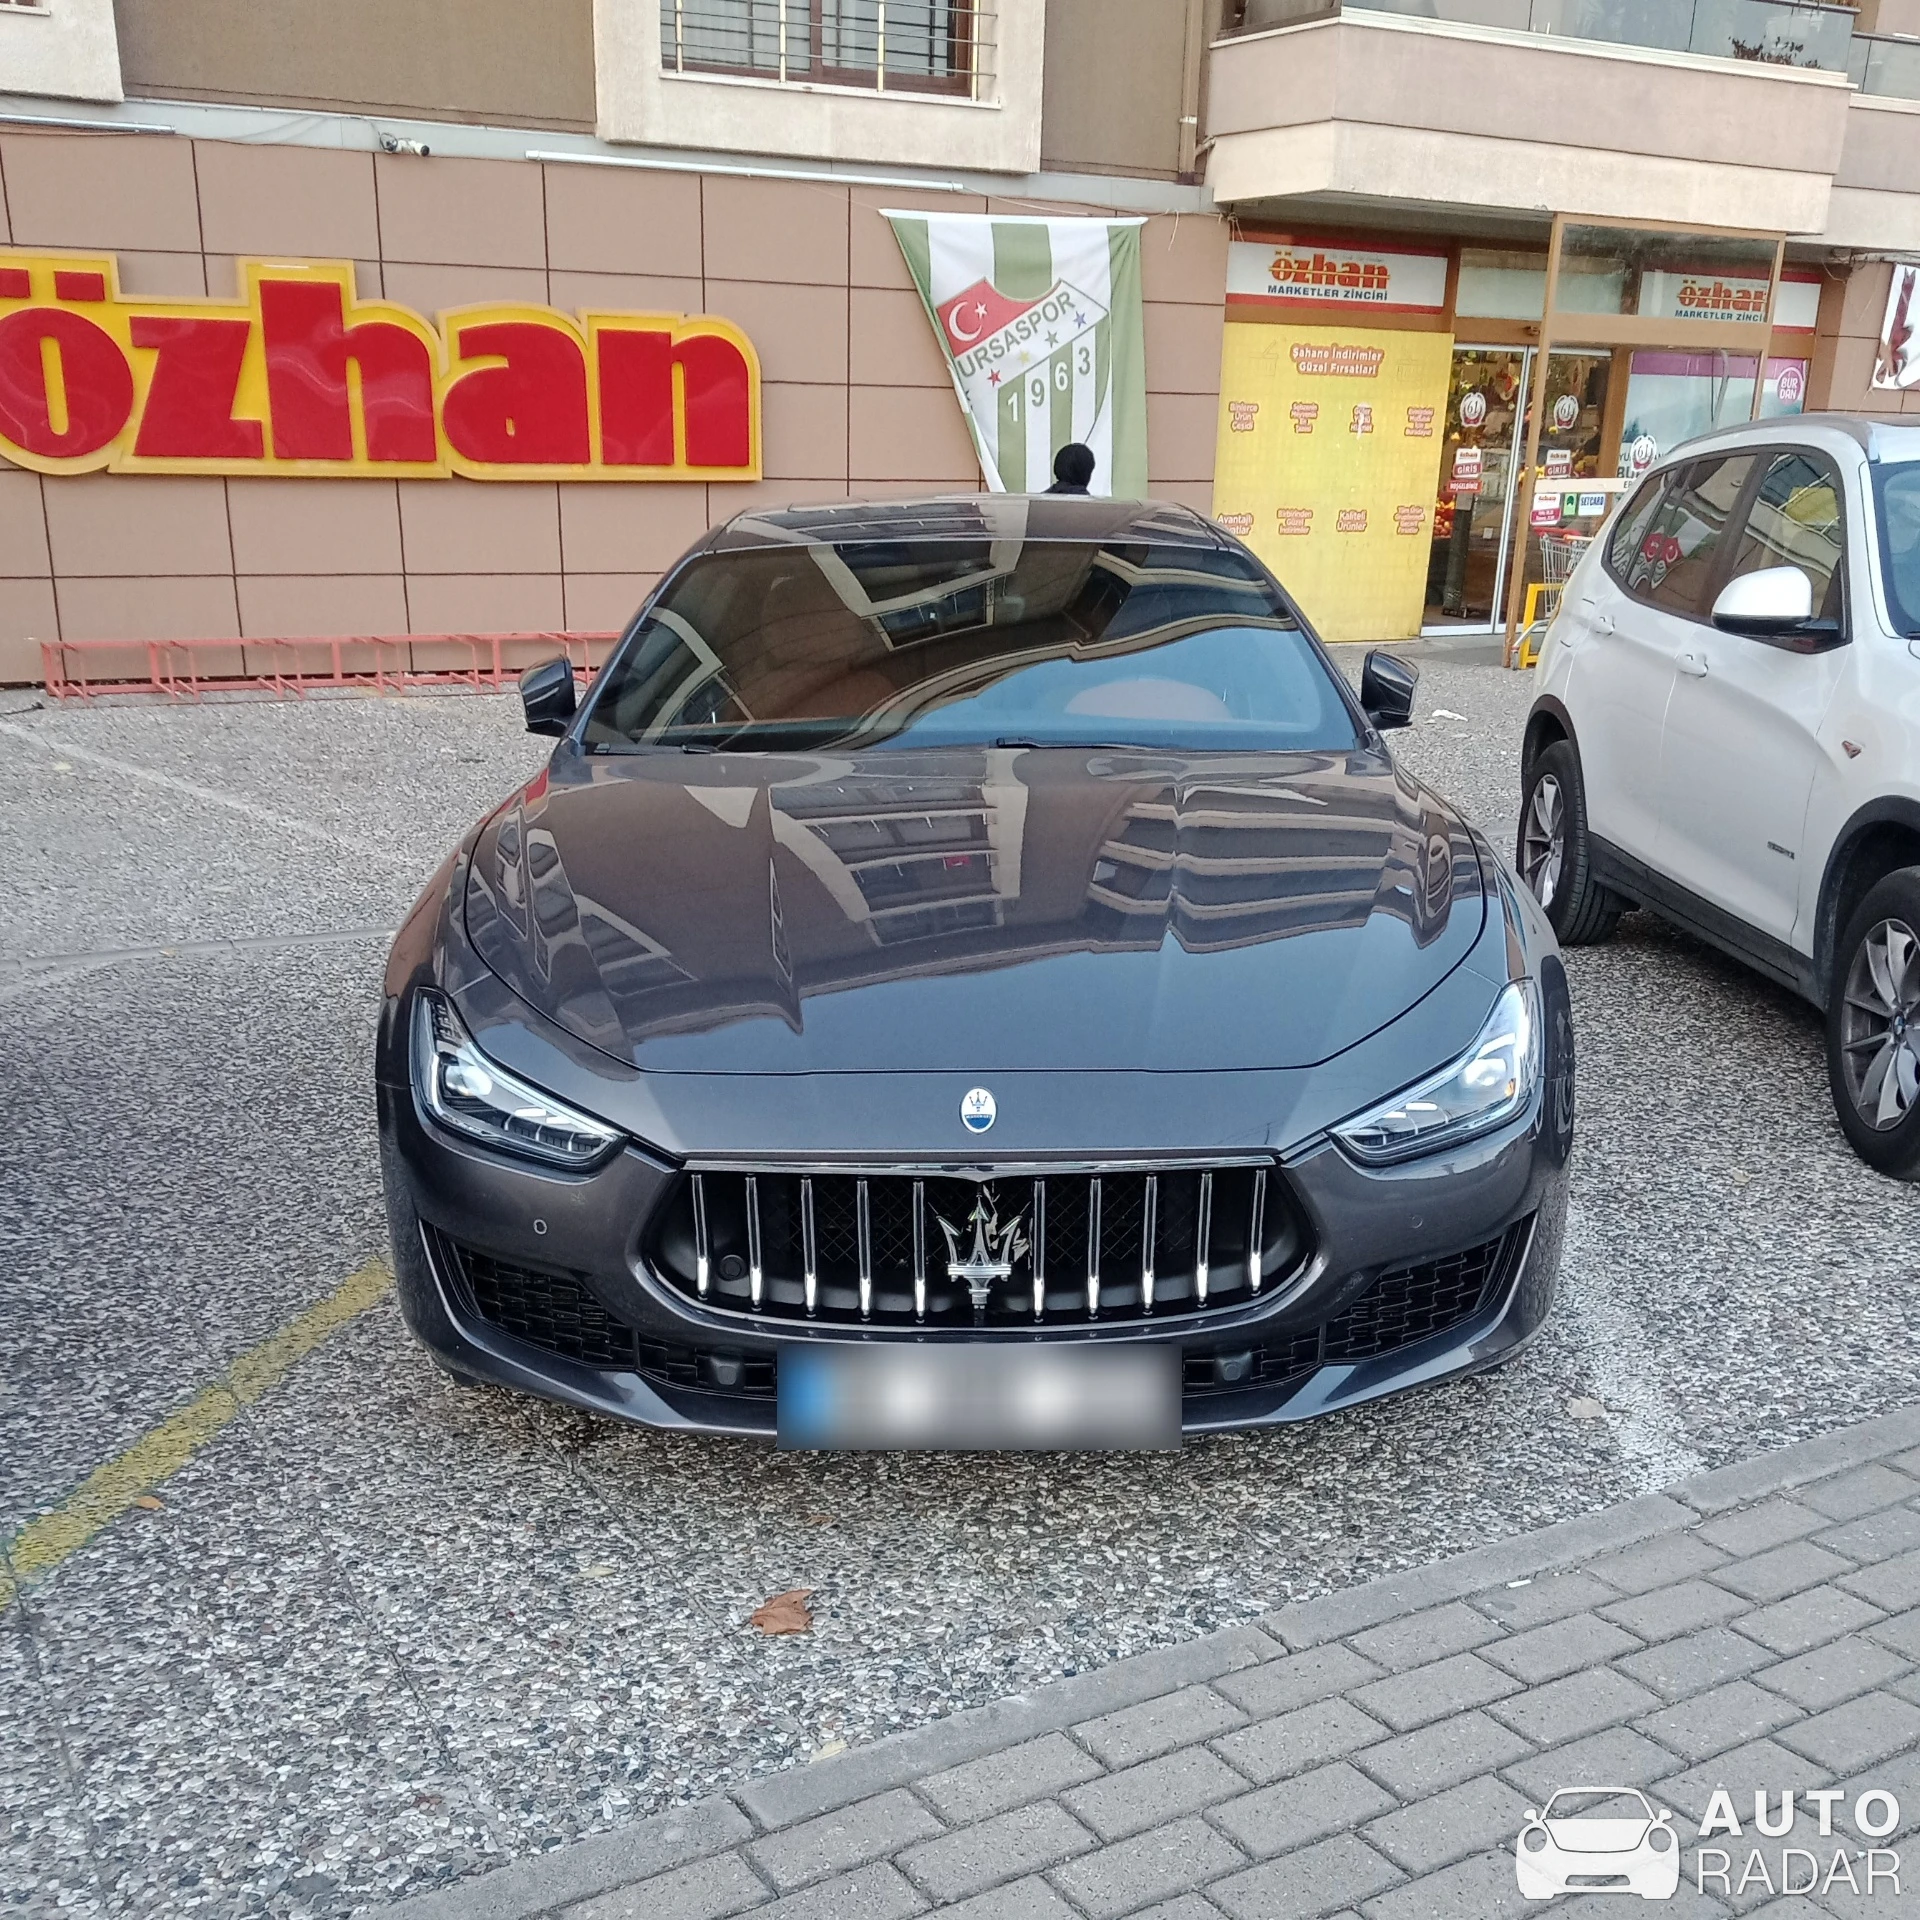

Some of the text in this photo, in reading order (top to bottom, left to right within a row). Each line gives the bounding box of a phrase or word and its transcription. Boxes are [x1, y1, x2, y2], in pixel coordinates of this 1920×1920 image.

[1269, 250, 1389, 289] özhan
[1267, 285, 1388, 301] MARKETLER ZİNCİRİ
[1675, 309, 1766, 322] MARKETLER ZİNCİ
[956, 290, 1076, 378] URSASPOR
[1292, 346, 1382, 361] Şahane İndirimler
[0, 267, 750, 466] özhan
[1299, 361, 1327, 372] Güzel
[1007, 346, 1092, 422] 1963
[1781, 377, 1798, 389] BUR
[1780, 388, 1797, 400] DAN
